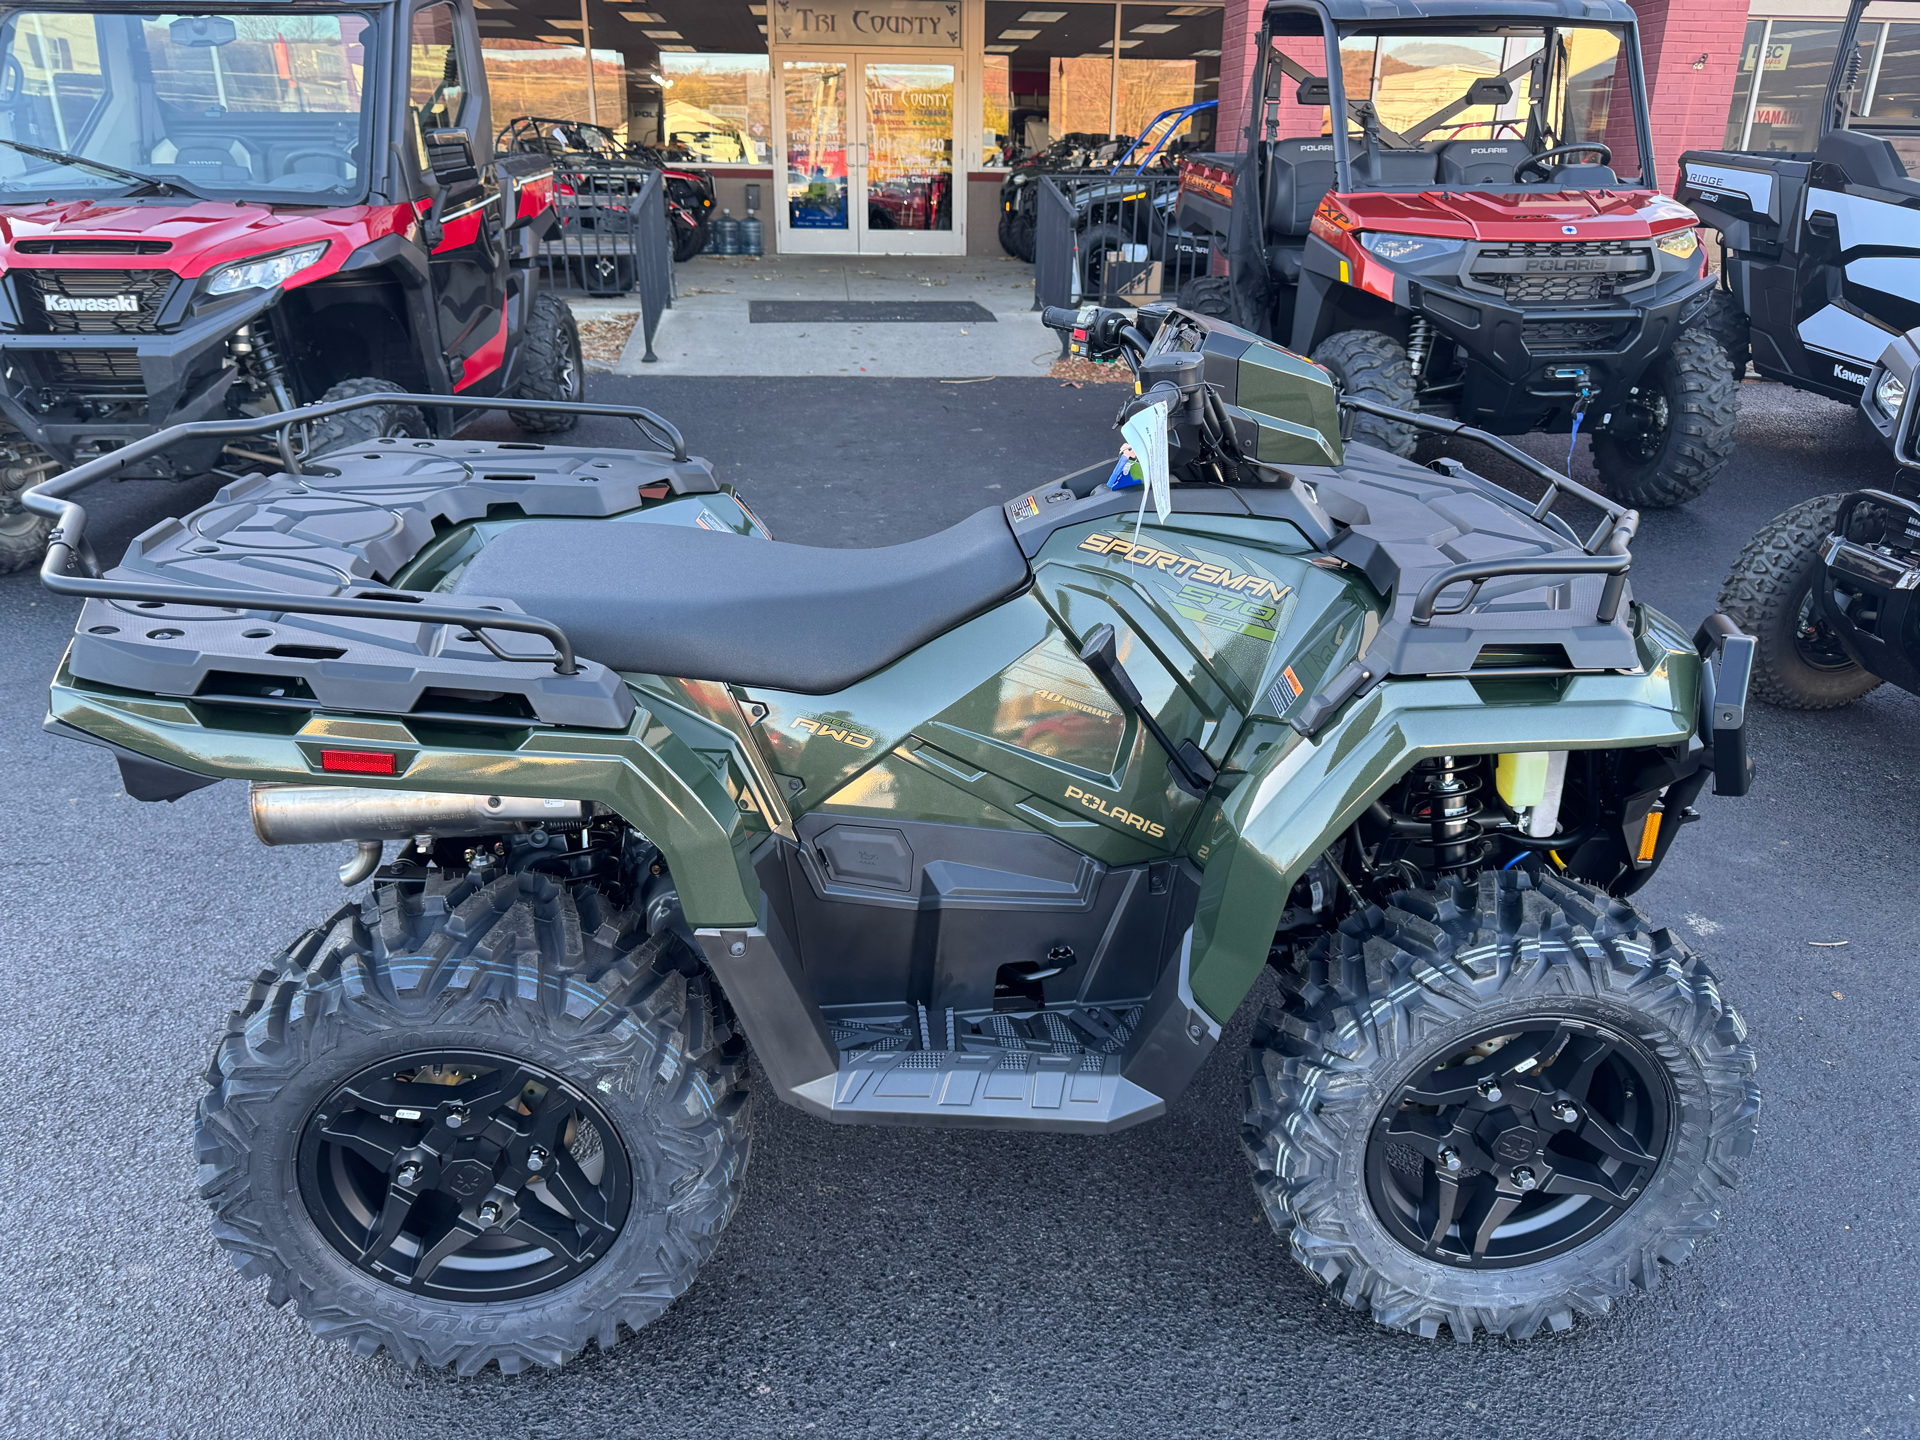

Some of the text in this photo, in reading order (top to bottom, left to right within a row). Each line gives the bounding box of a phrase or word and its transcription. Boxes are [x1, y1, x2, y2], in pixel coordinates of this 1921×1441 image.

[852, 10, 941, 35] COUNTY
[1751, 45, 1785, 59] BC
[1757, 110, 1804, 124] YAMAHA
[1300, 144, 1334, 152] POLARI
[1470, 146, 1509, 155] POLARIS
[1689, 172, 1724, 187] RIDGE
[1320, 203, 1352, 226] XP
[1525, 258, 1608, 272] POLARIS
[43, 294, 140, 312] Kawasaki
[1833, 363, 1870, 386] Kawas
[1077, 532, 1294, 604] SPORTSMAN
[1177, 583, 1276, 621] 570
[1199, 613, 1246, 632] EFI
[1035, 689, 1113, 719] 40 ANNIVERSARY
[789, 716, 875, 749] AWD
[1064, 784, 1166, 839] POLARIS
